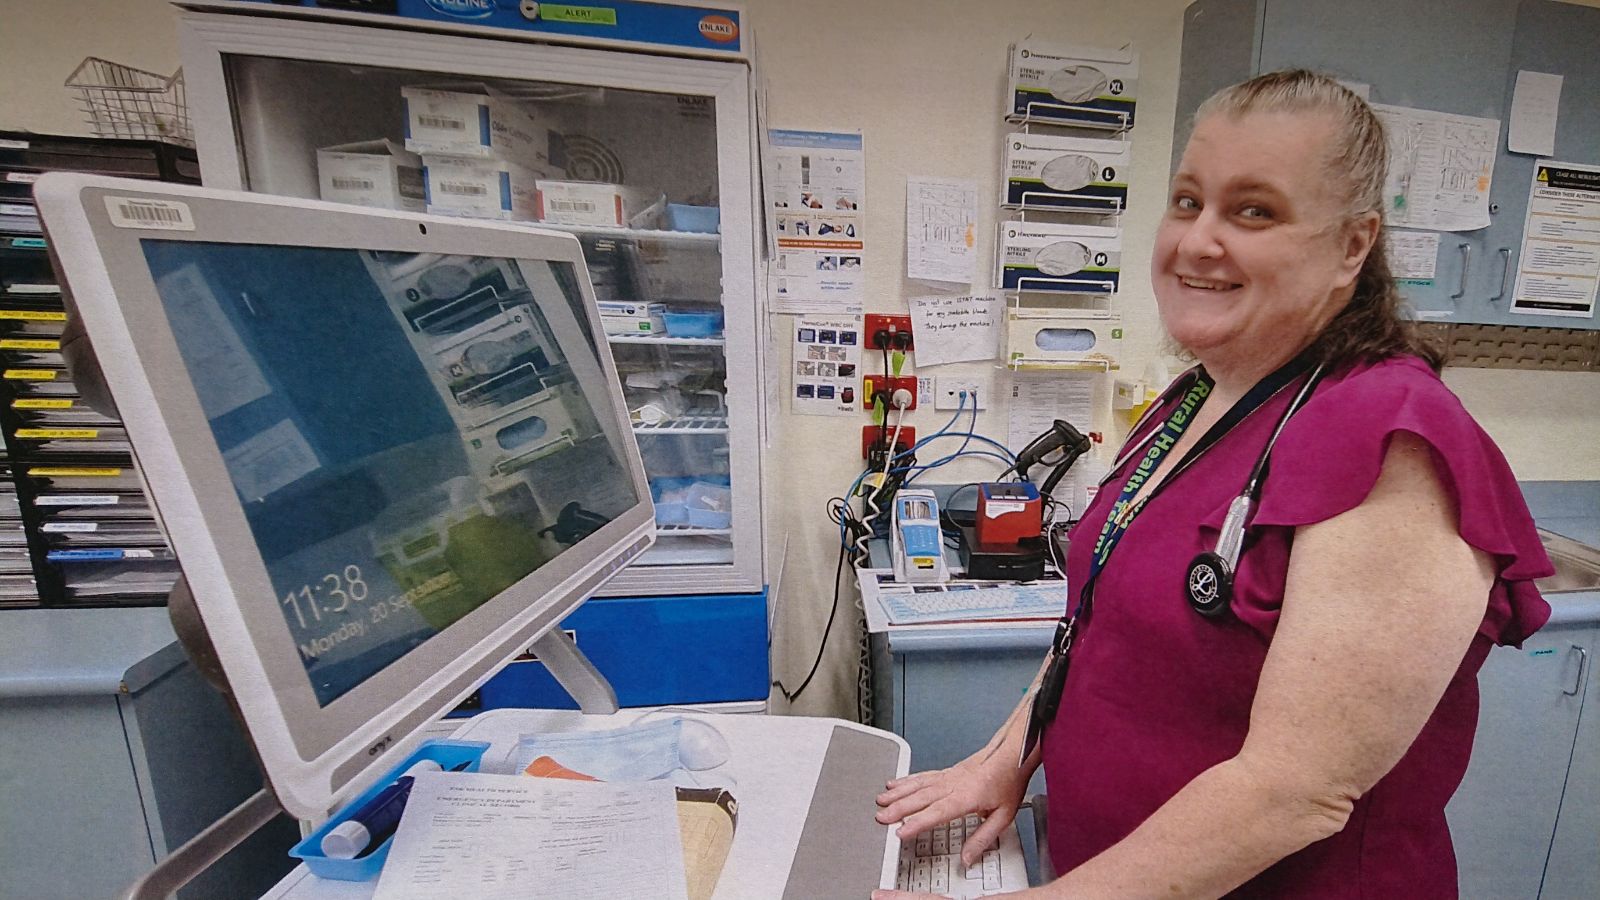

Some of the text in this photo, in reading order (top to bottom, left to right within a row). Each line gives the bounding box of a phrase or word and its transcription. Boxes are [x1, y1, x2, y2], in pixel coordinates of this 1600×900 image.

[565, 9, 591, 19] ALERT
[1110, 82, 1122, 92] XL
[1105, 170, 1111, 179] L
[1096, 255, 1106, 264] M
[1167, 379, 1211, 433] Rural
[1123, 431, 1175, 494] Health
[284, 564, 369, 629] 11:38
[369, 602, 388, 623] 20
[368, 736, 392, 756] onyx
